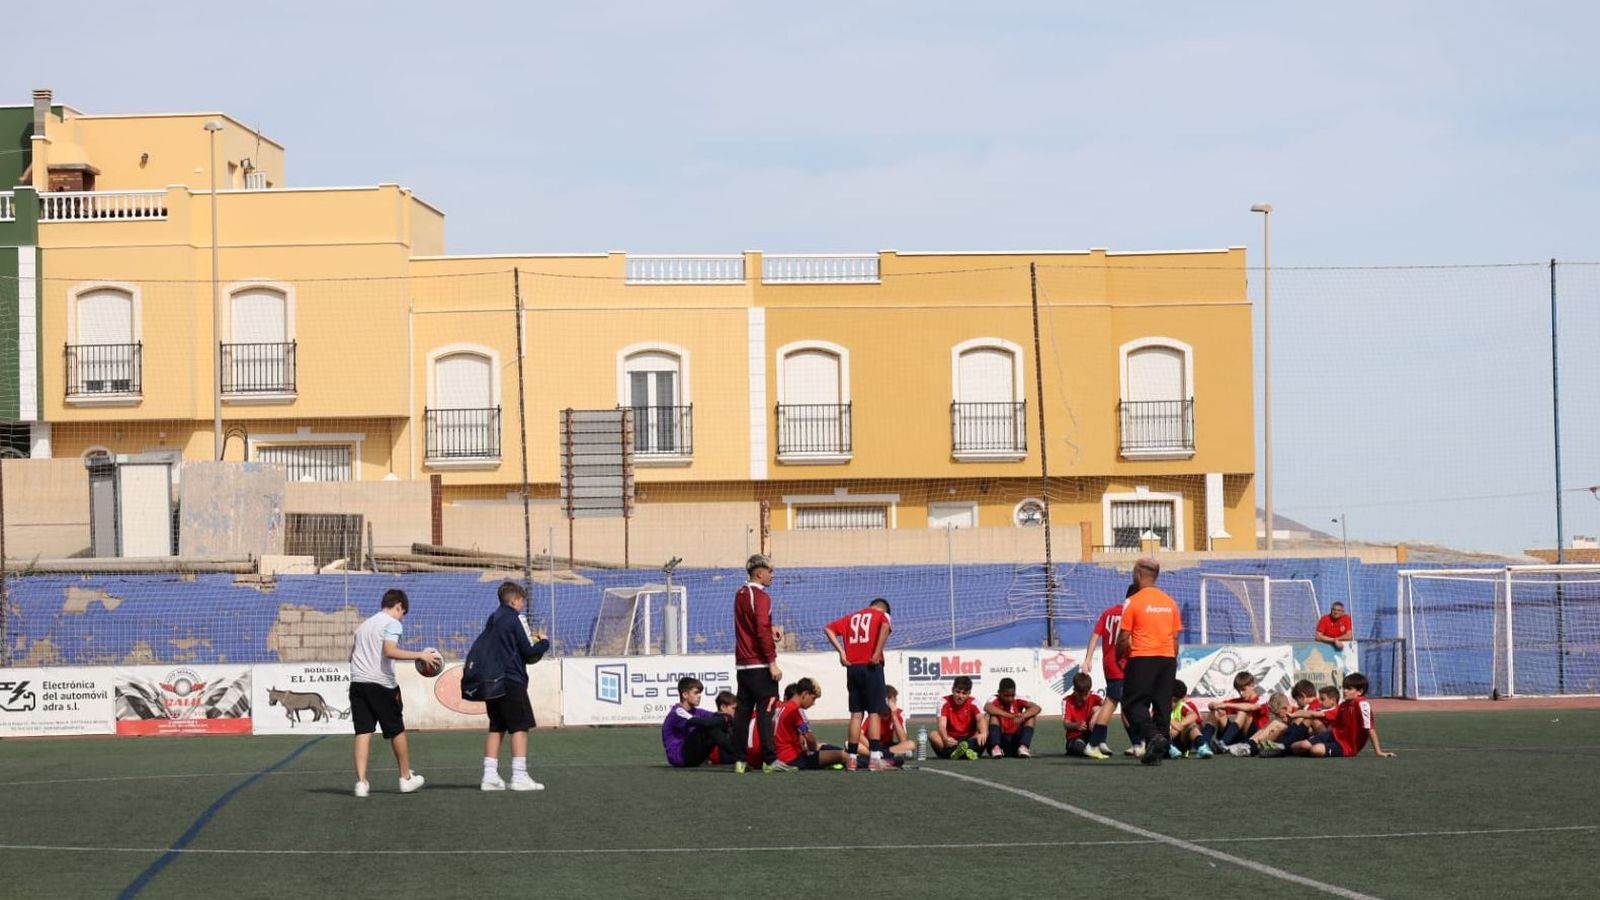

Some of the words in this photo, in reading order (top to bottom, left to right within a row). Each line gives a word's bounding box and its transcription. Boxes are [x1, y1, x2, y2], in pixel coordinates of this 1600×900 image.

[849, 613, 873, 644] 99
[908, 656, 983, 680] BigMat
[290, 675, 306, 683] EL
[42, 680, 95, 690] Electrónica
[42, 692, 58, 701] del
[60, 690, 108, 700] automóvil
[42, 703, 64, 711] adra
[66, 702, 80, 711] s.l.
